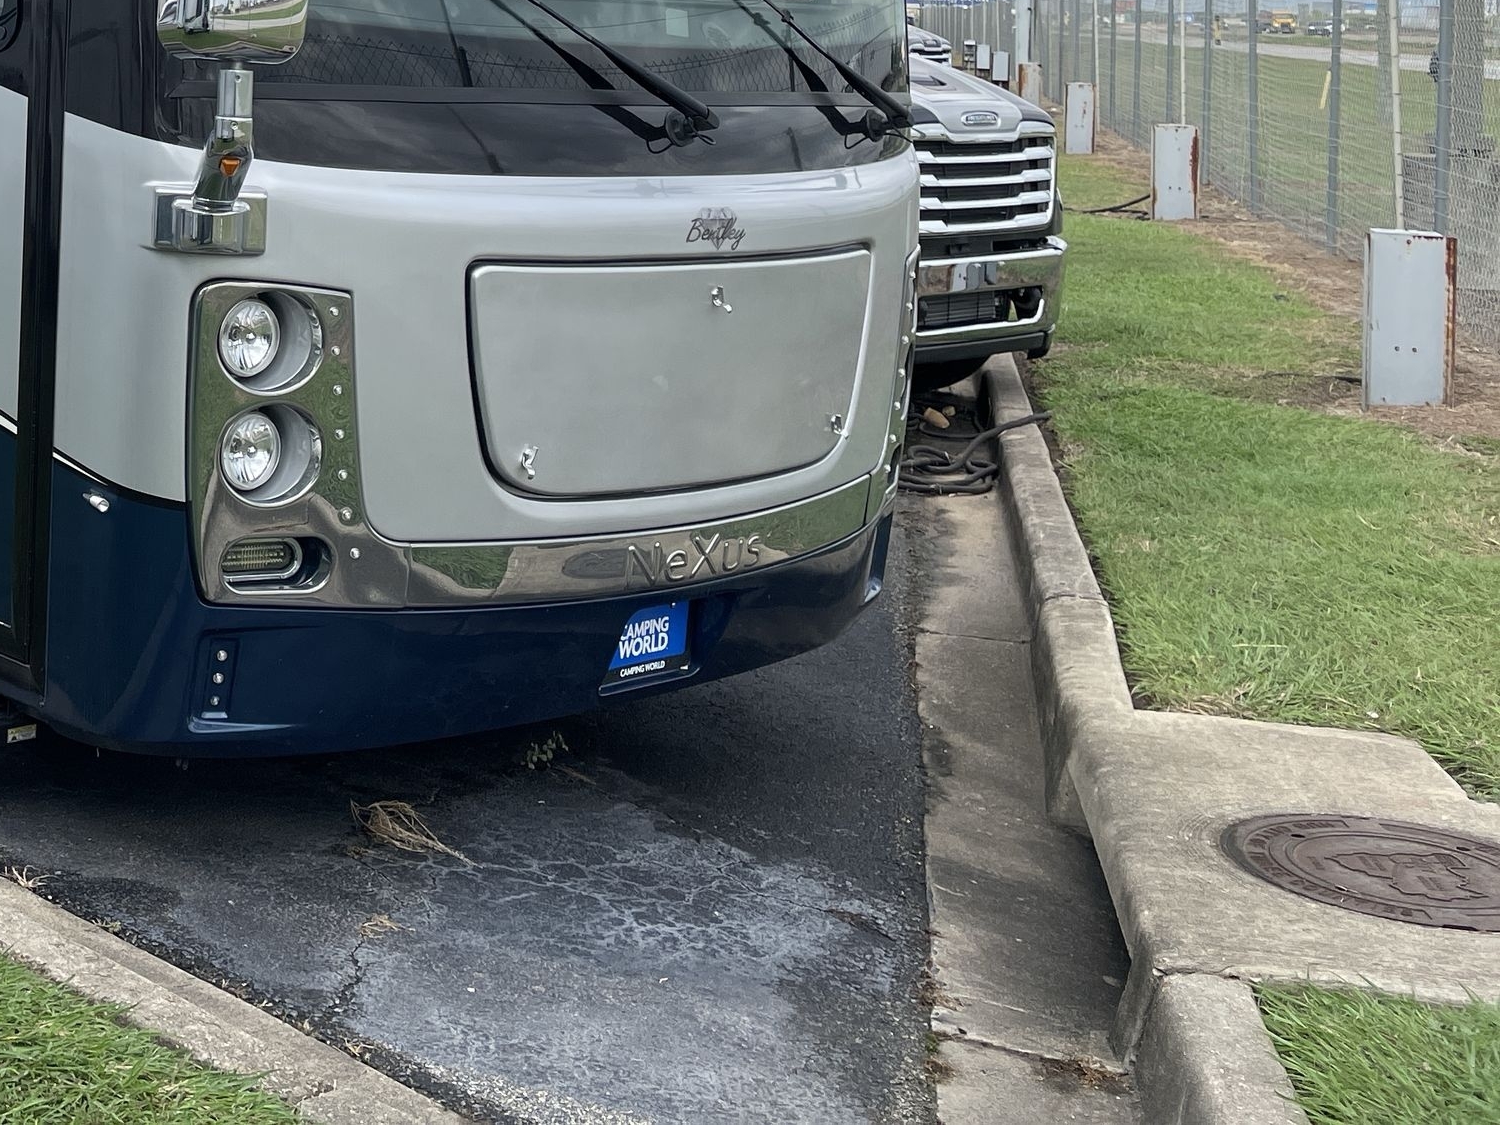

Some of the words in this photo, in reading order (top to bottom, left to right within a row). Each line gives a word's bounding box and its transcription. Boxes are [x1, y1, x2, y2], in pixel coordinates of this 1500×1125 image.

[686, 217, 746, 251] Bentley
[626, 532, 761, 589] NeXus
[619, 632, 669, 660] WORLD
[620, 664, 645, 678] CAMPING
[645, 660, 666, 672] WORLD
